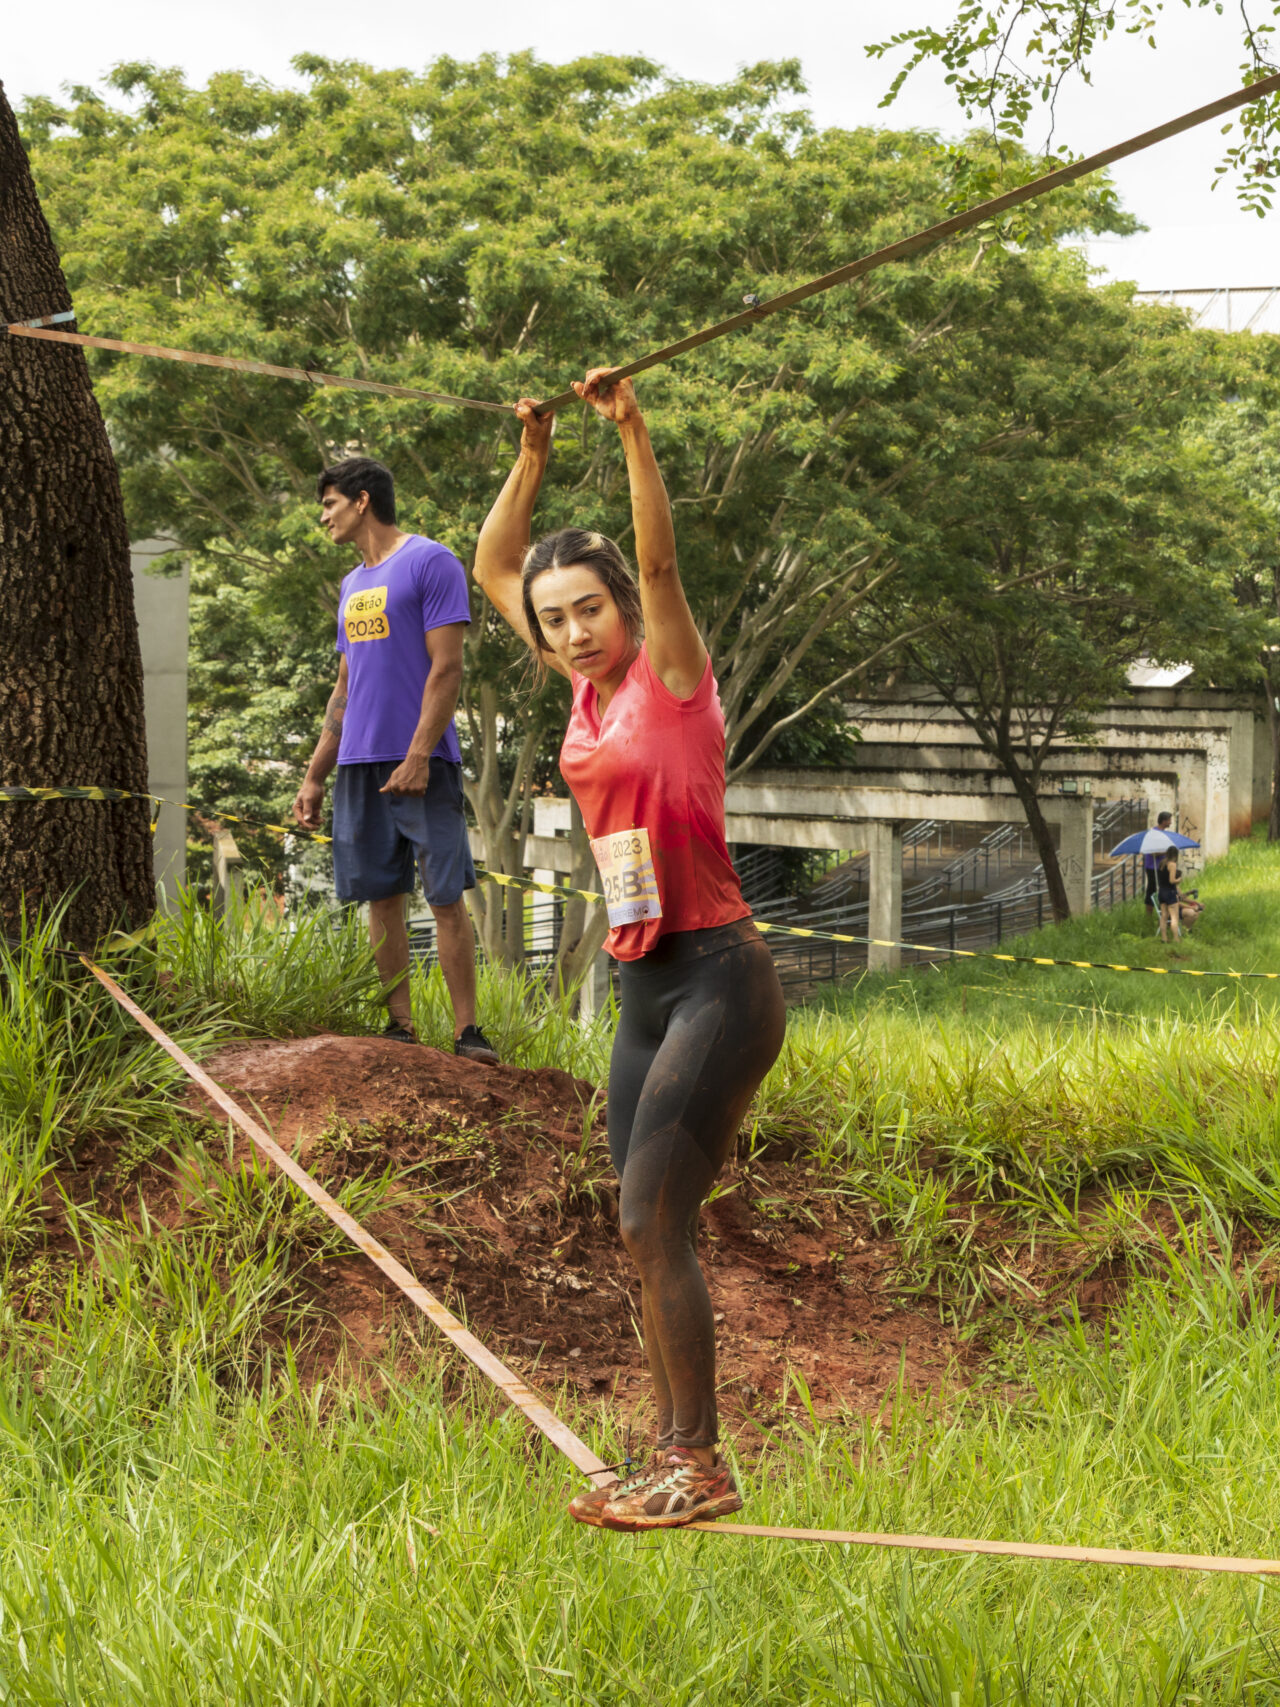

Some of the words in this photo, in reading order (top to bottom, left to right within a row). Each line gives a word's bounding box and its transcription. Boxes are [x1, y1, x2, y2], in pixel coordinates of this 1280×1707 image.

[349, 595, 382, 611] verão
[347, 618, 384, 637] 2023
[612, 838, 643, 859] 2023
